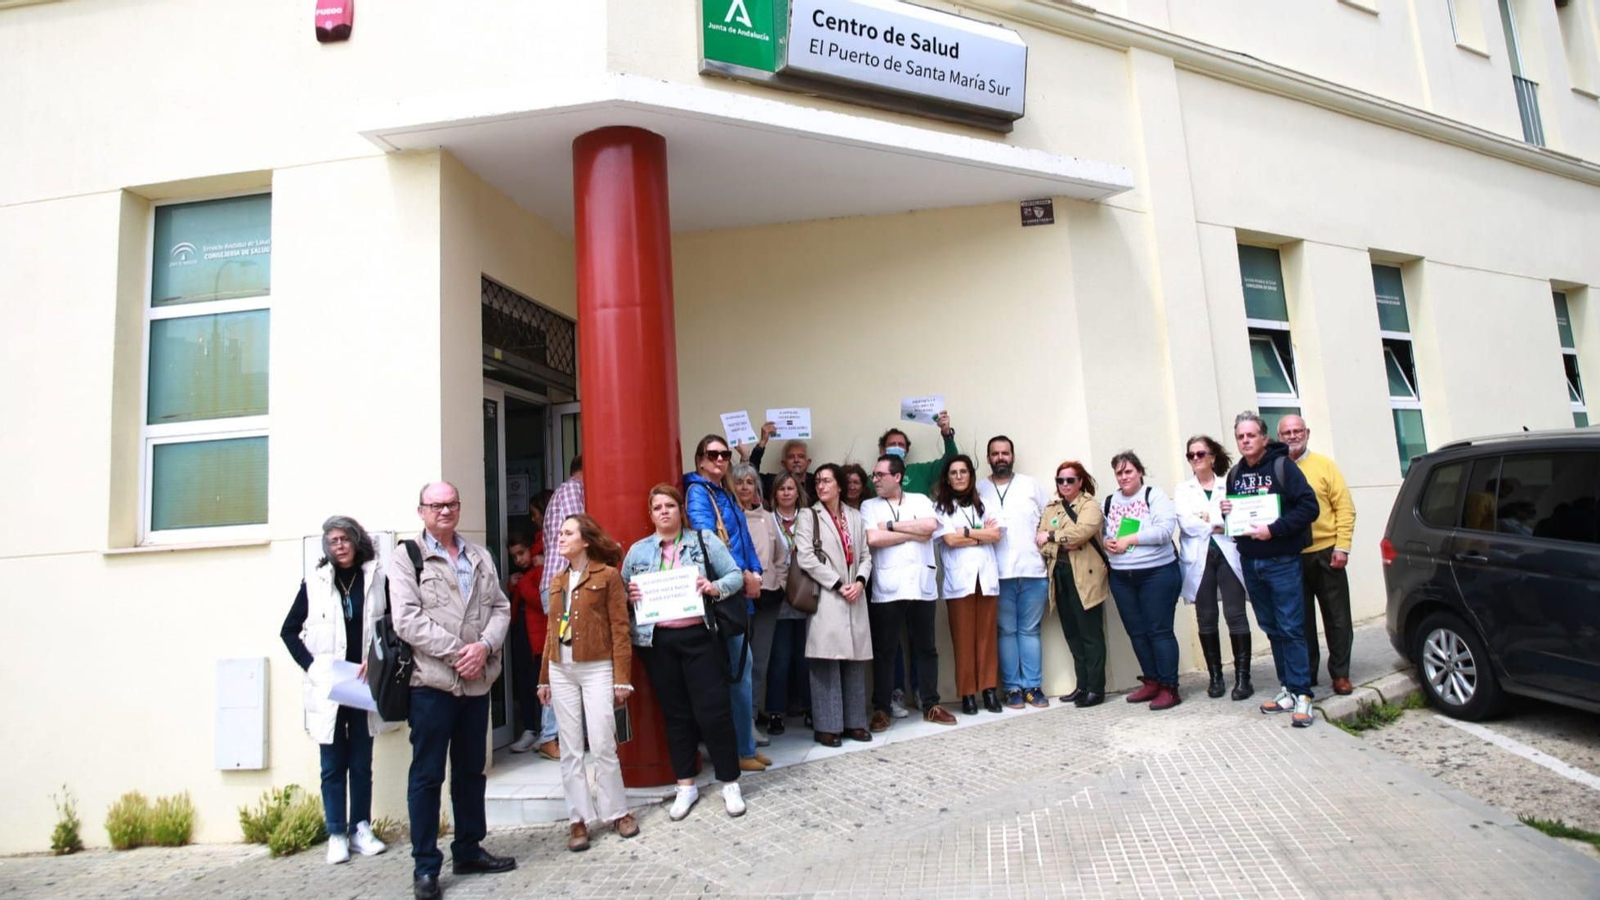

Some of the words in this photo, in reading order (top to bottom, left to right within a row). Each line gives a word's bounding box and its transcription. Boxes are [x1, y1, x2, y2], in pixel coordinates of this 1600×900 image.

[708, 22, 727, 31] Junta
[728, 26, 736, 34] de
[737, 28, 770, 41] Andalucía
[812, 9, 878, 40] Centro
[883, 26, 905, 46] de
[910, 33, 959, 59] Salud
[809, 38, 823, 55] El
[828, 42, 880, 67] Puerto
[883, 55, 902, 72] de
[905, 60, 945, 82] Santa
[949, 70, 985, 91] María
[988, 79, 1011, 97] Sur
[1234, 475, 1273, 490] PARIS
